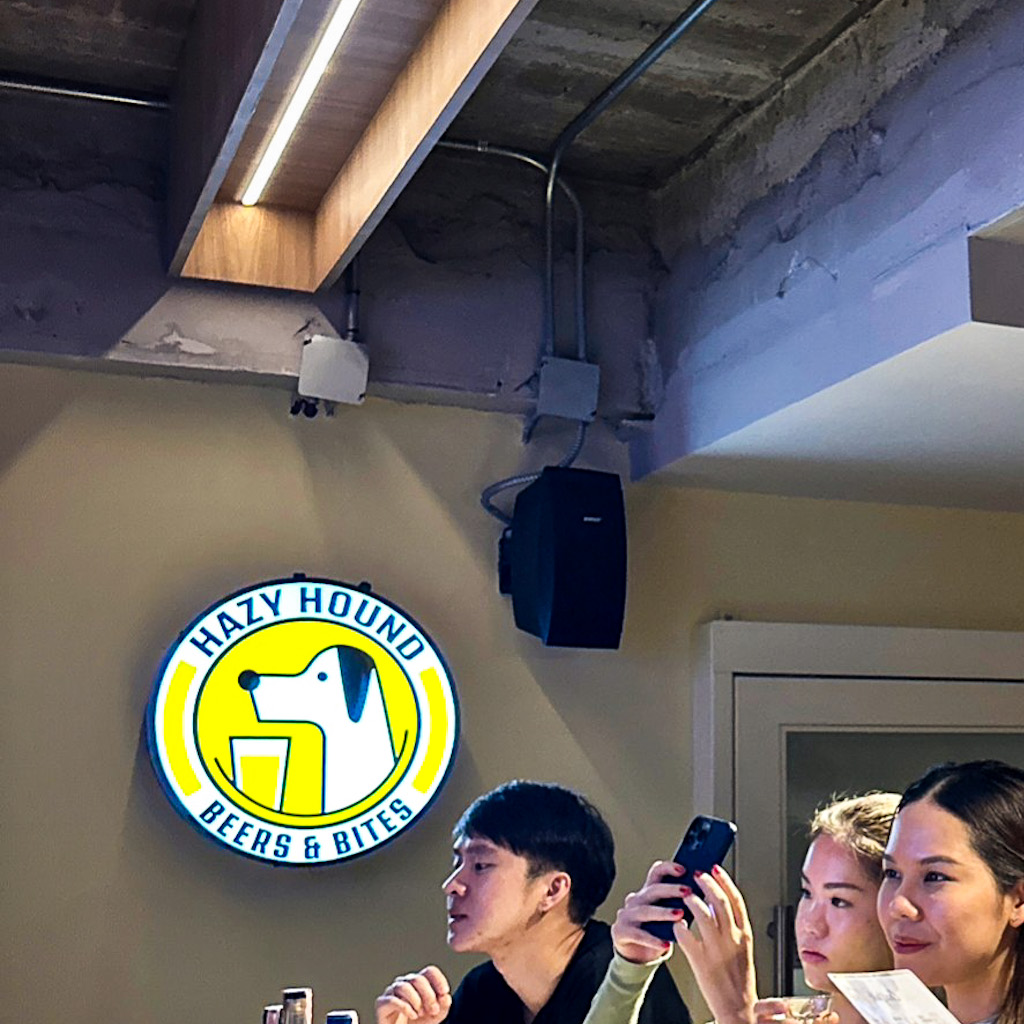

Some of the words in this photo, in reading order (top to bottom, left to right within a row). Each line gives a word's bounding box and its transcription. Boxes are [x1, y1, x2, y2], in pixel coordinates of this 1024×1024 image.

[189, 588, 282, 658] HAZY
[299, 586, 426, 662] HOUND
[199, 799, 292, 859] BEERS
[304, 835, 321, 860] &
[332, 797, 413, 856] BITES
